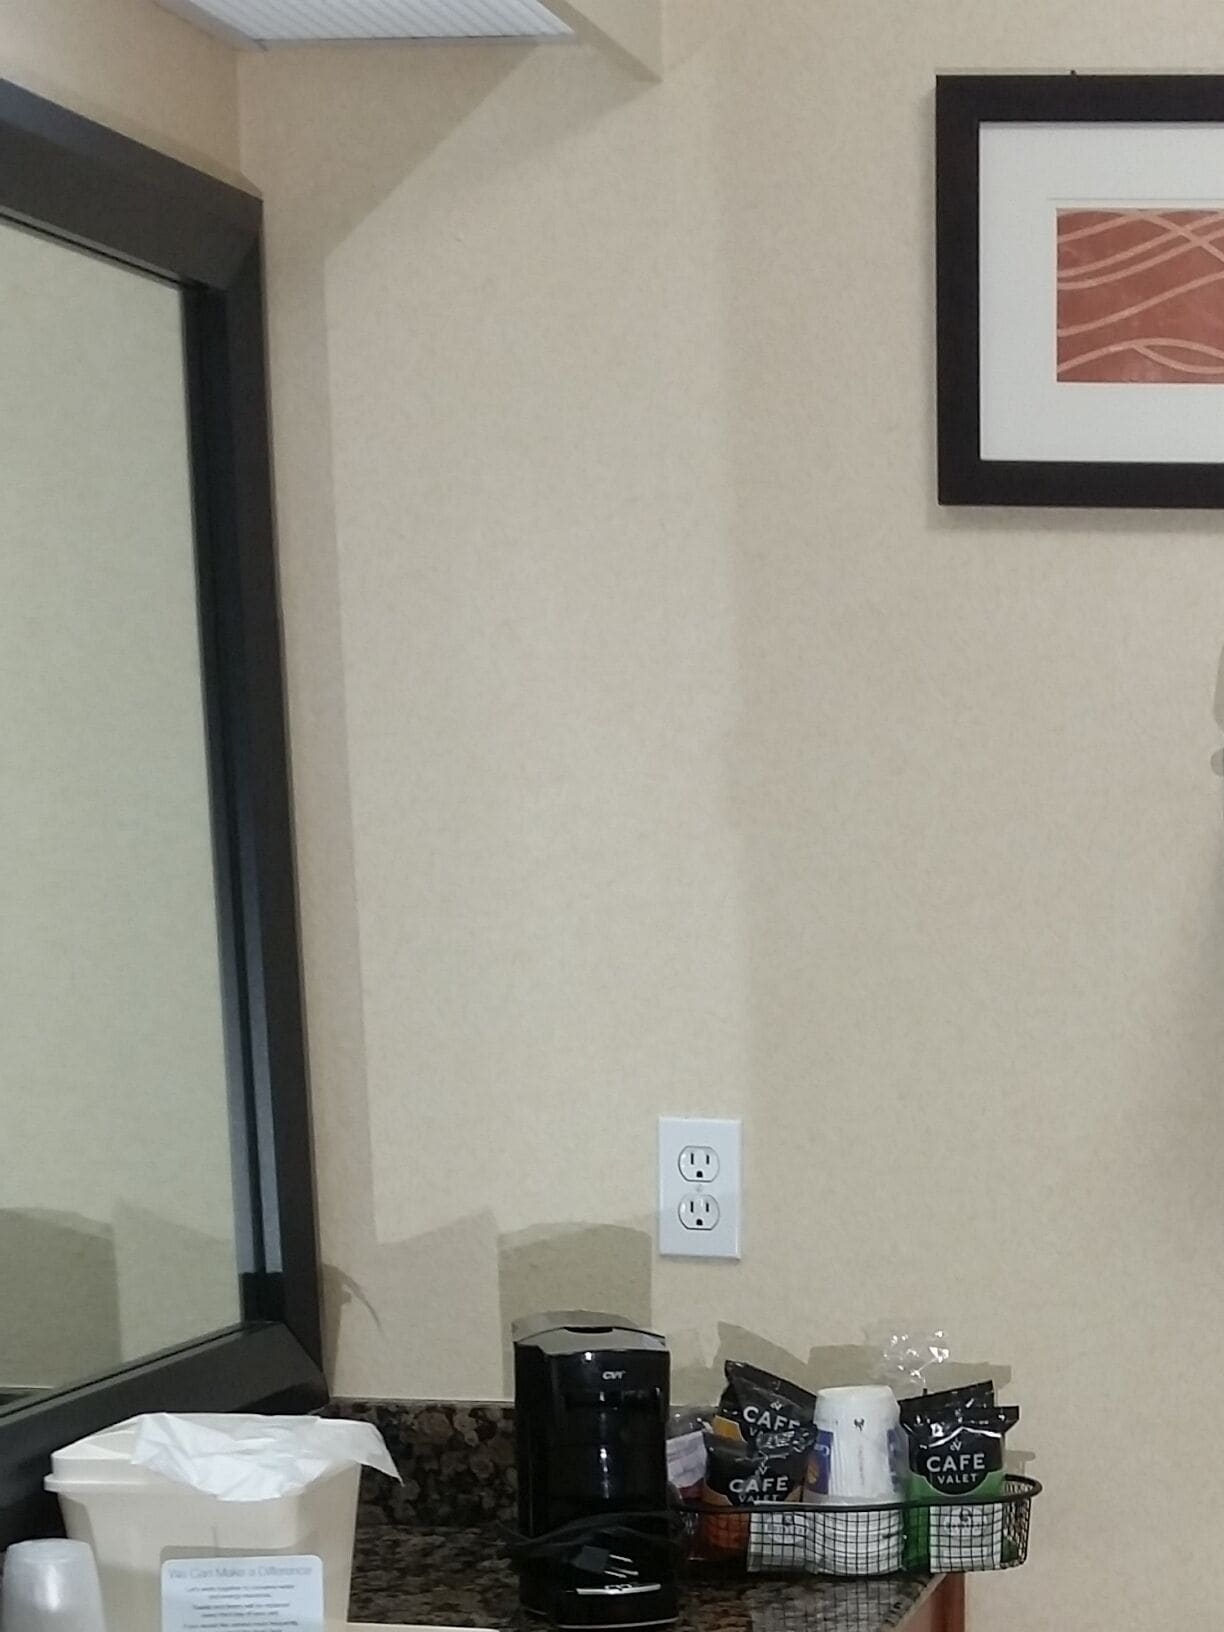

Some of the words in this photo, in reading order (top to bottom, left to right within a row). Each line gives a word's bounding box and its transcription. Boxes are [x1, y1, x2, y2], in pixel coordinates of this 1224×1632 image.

[926, 1453, 986, 1473] CAFE
[729, 1475, 789, 1493] CAFE
[937, 1473, 978, 1485] VALET
